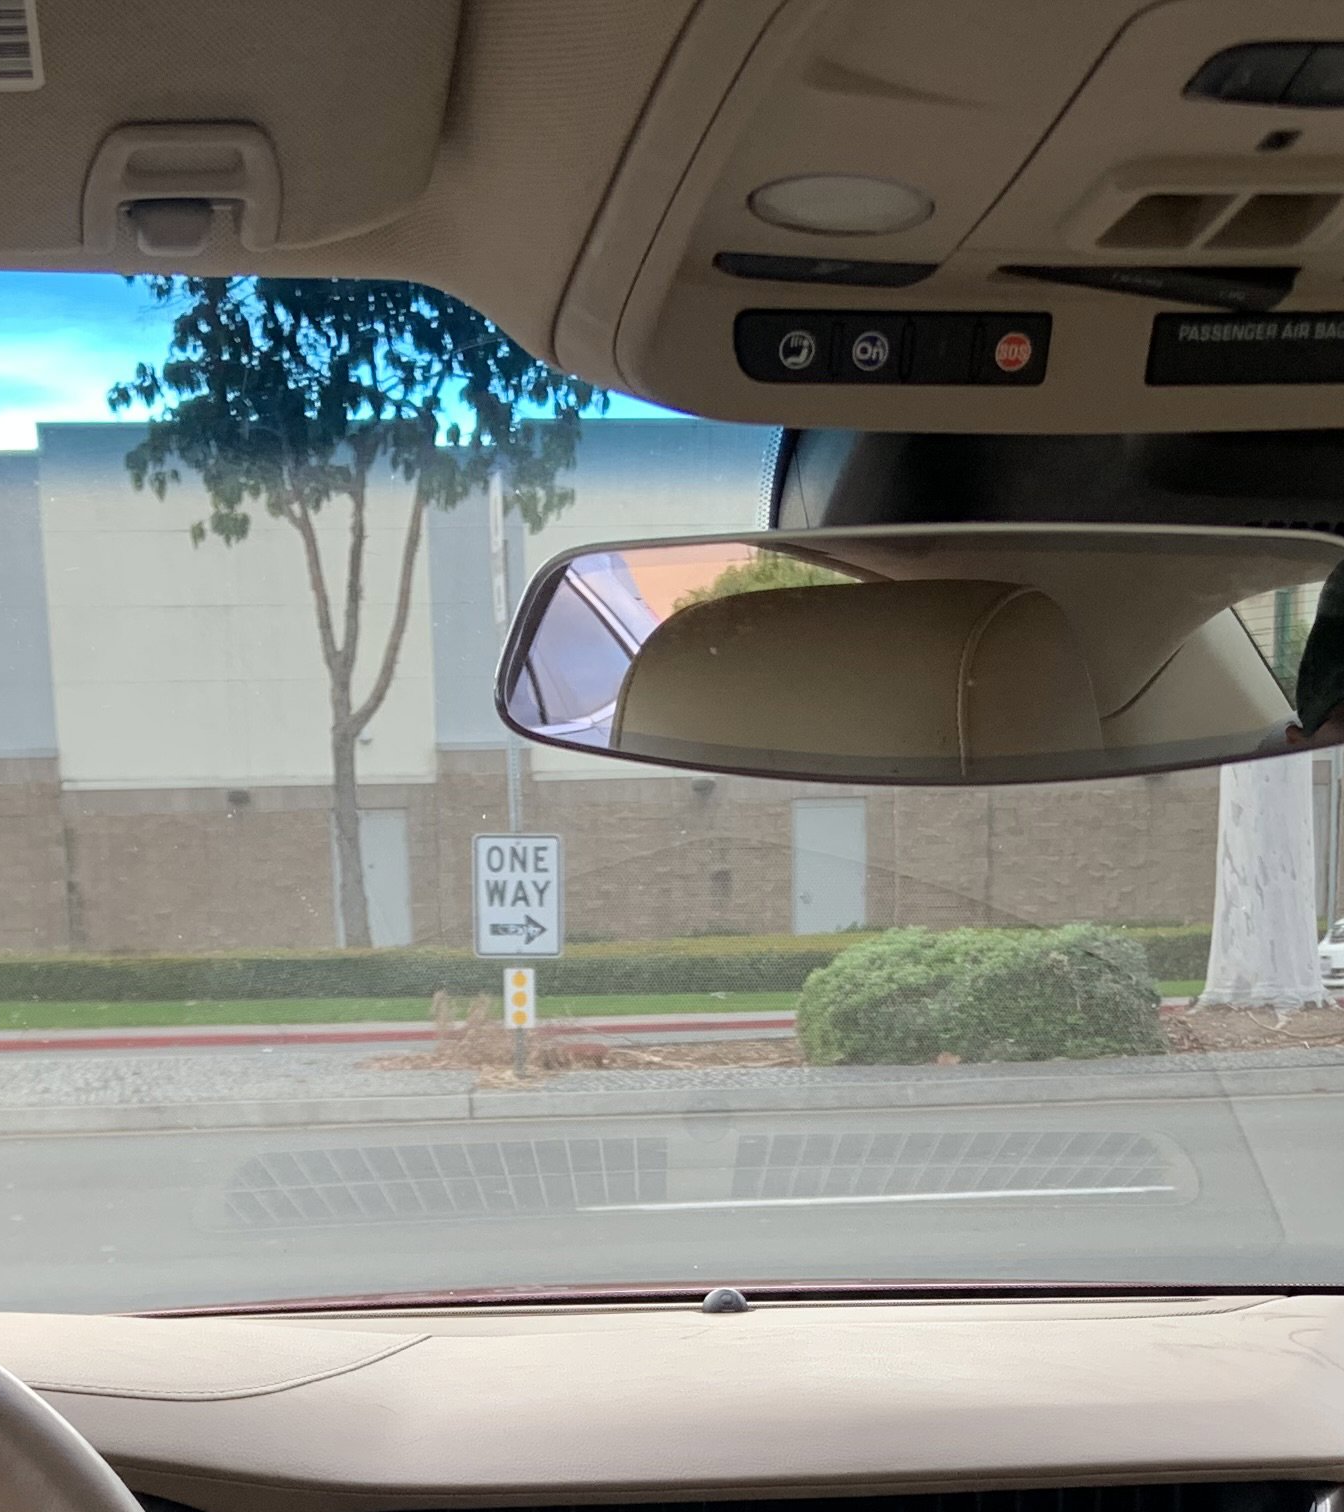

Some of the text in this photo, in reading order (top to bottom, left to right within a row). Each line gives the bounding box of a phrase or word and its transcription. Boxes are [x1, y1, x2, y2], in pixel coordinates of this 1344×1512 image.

[1179, 321, 1278, 341] PASSENGER
[1281, 320, 1310, 339] AIR
[998, 344, 1030, 361] SOS
[486, 845, 549, 873] ONE
[485, 879, 551, 907] WAY
